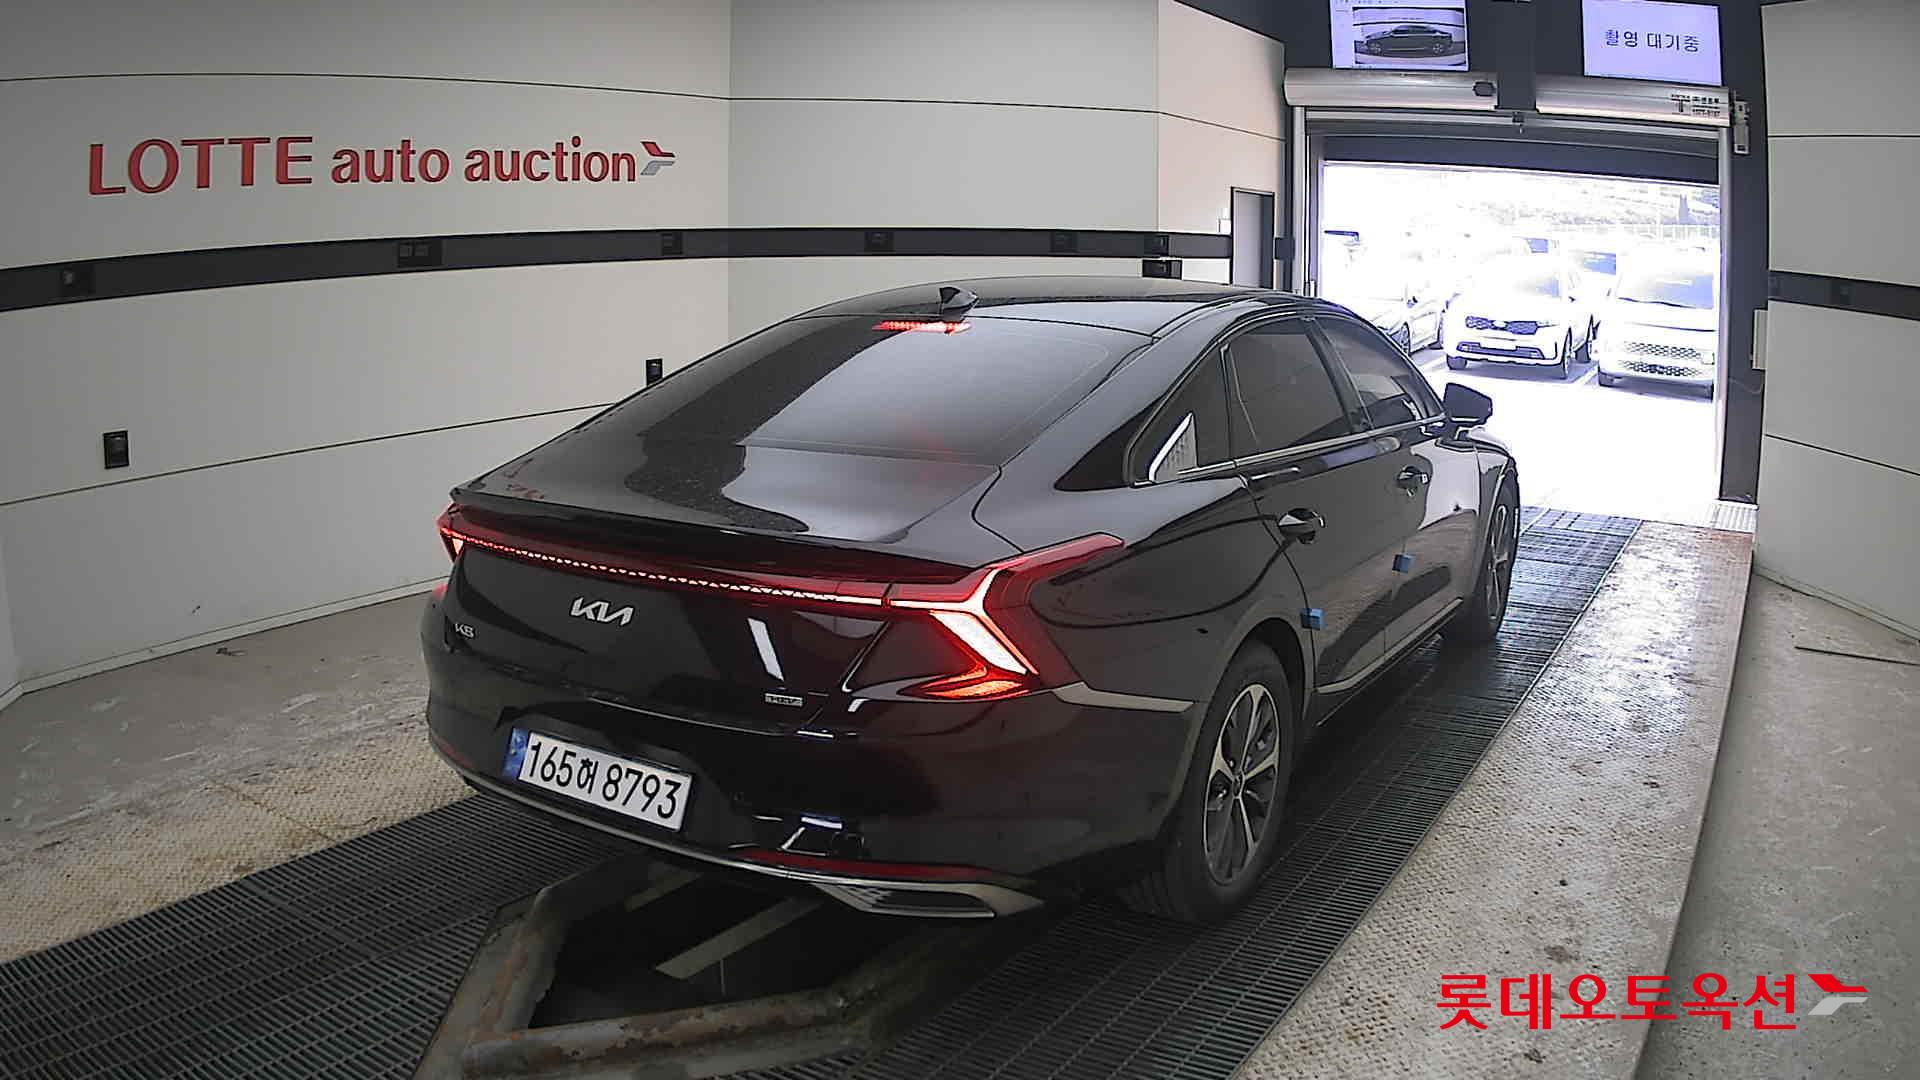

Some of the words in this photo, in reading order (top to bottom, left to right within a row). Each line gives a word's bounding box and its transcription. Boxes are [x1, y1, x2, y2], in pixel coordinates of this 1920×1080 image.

[1646, 33, 1699, 52] 대기중
[88, 136, 313, 196] LOTTE
[331, 139, 450, 183] auto
[464, 135, 637, 183] auction
[570, 597, 634, 626] KIA
